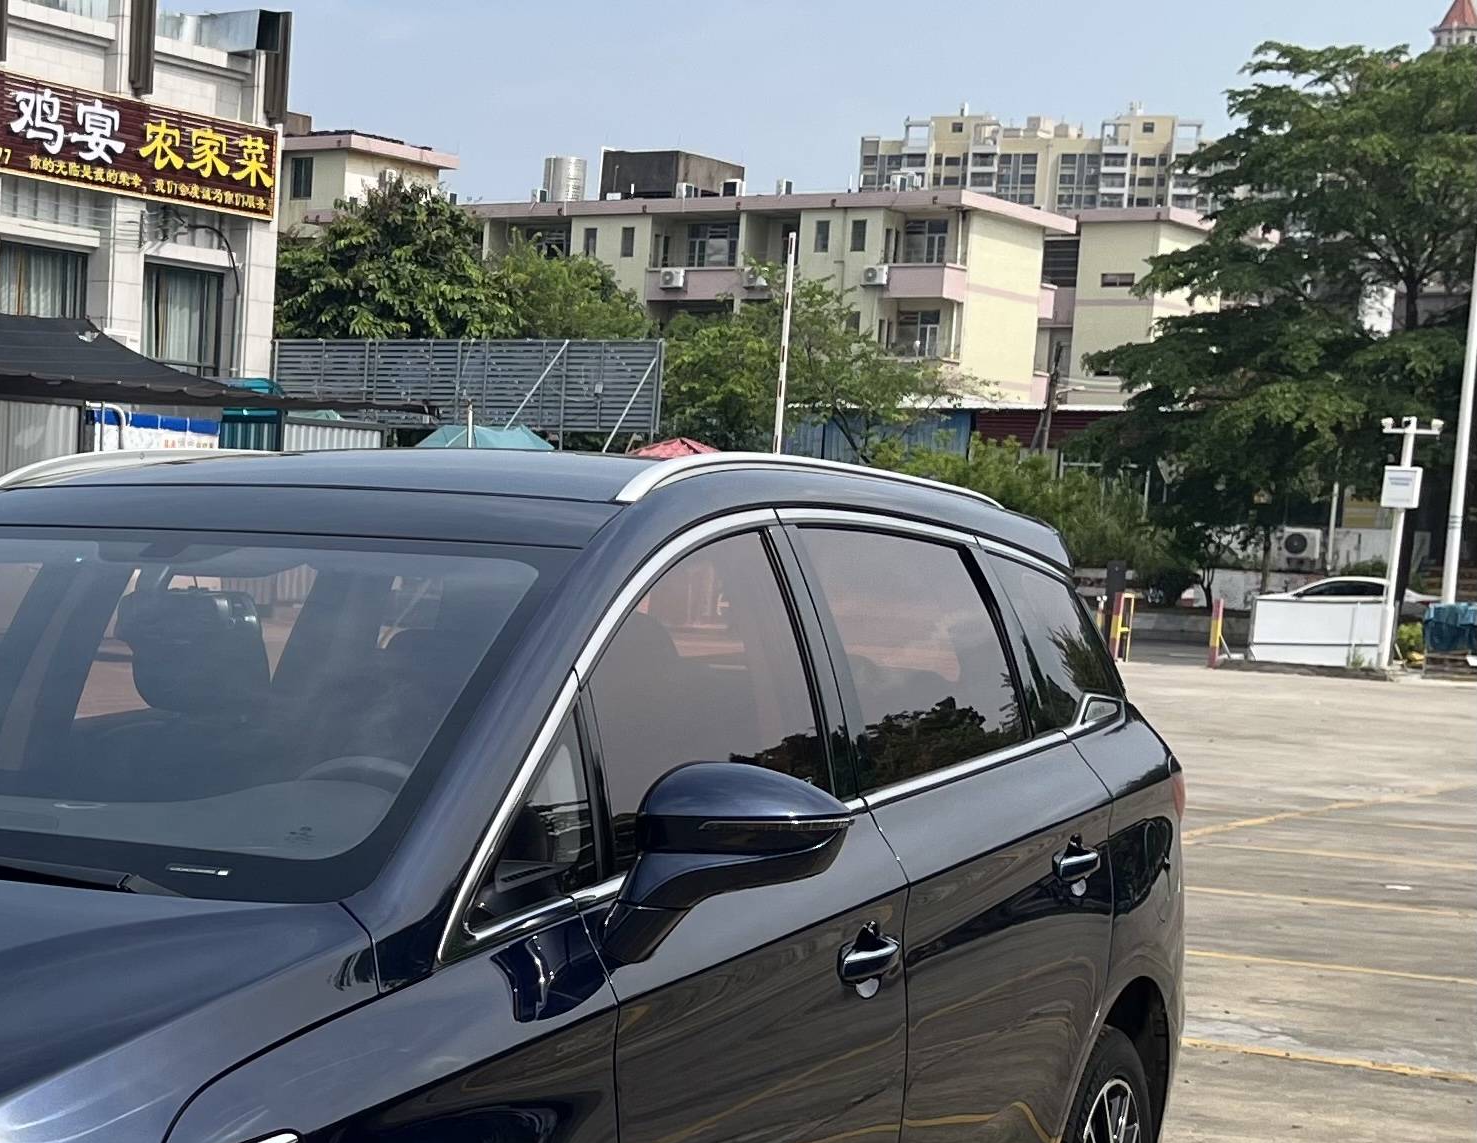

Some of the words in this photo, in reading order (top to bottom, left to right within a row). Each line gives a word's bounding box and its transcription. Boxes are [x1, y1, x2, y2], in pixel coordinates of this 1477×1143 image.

[10, 87, 126, 165] 鸡宴
[138, 118, 276, 189] 农家菜
